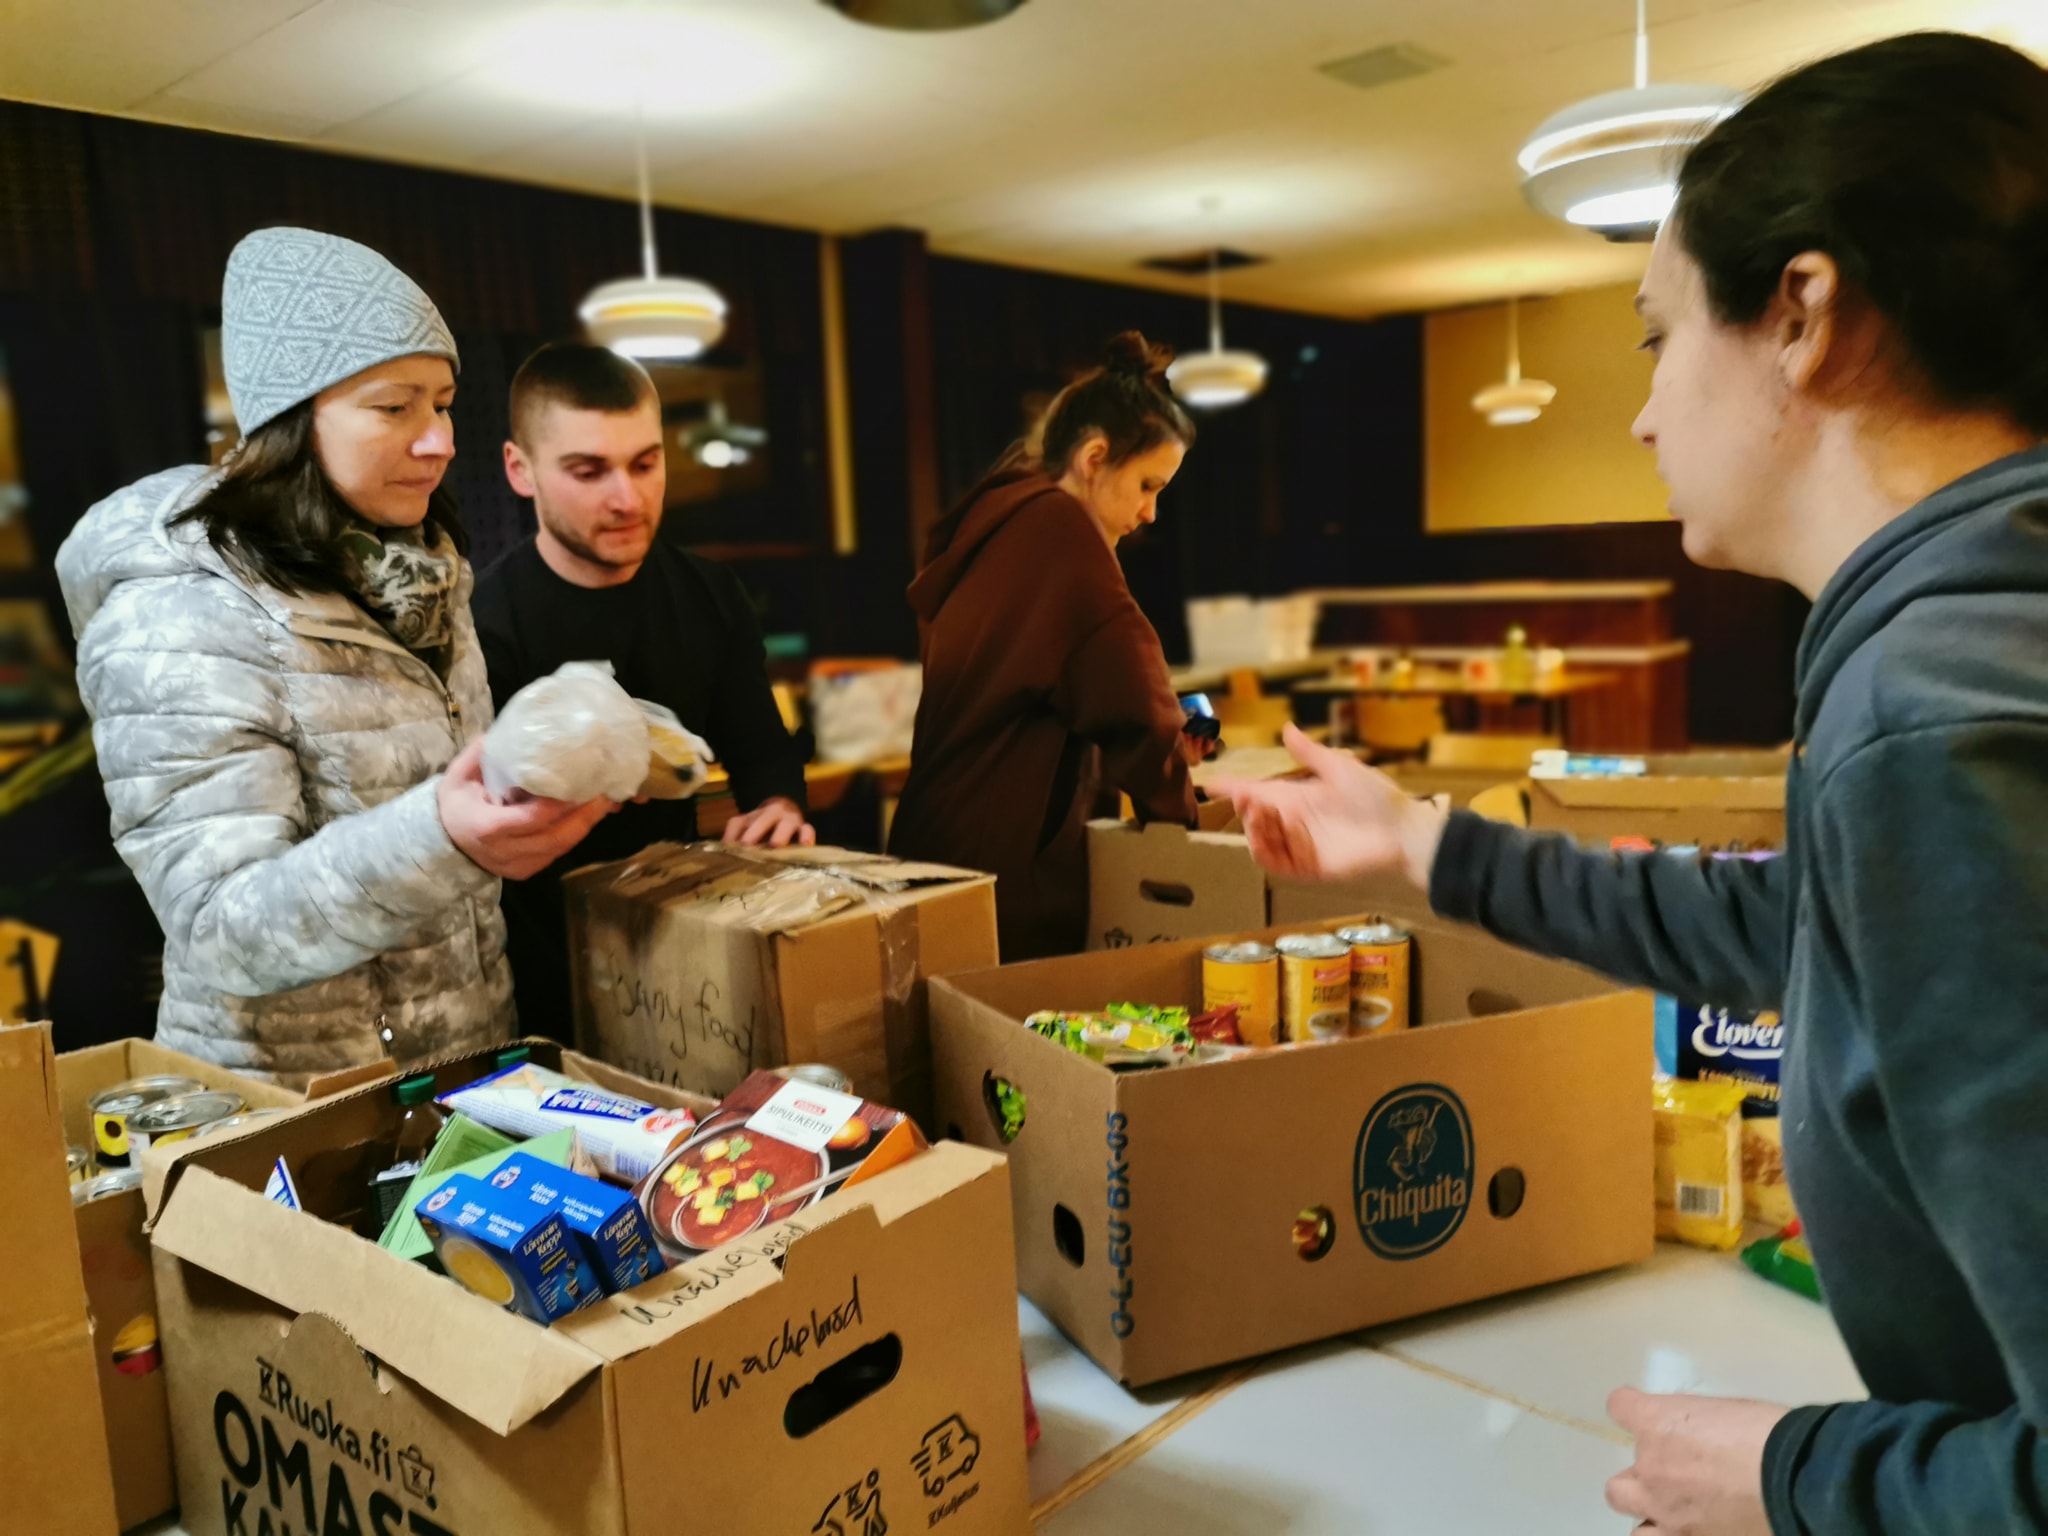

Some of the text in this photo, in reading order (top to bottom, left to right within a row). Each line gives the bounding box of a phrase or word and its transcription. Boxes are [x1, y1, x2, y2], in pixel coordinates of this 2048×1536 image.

[766, 1103, 833, 1136] SIPULIKEITTO
[1359, 1175, 1467, 1227] Chiquita
[524, 1221, 559, 1256] Lämmin
[604, 1208, 635, 1240] Lämmin
[537, 1230, 562, 1258] Kuppi
[213, 1389, 459, 1536] OMA
